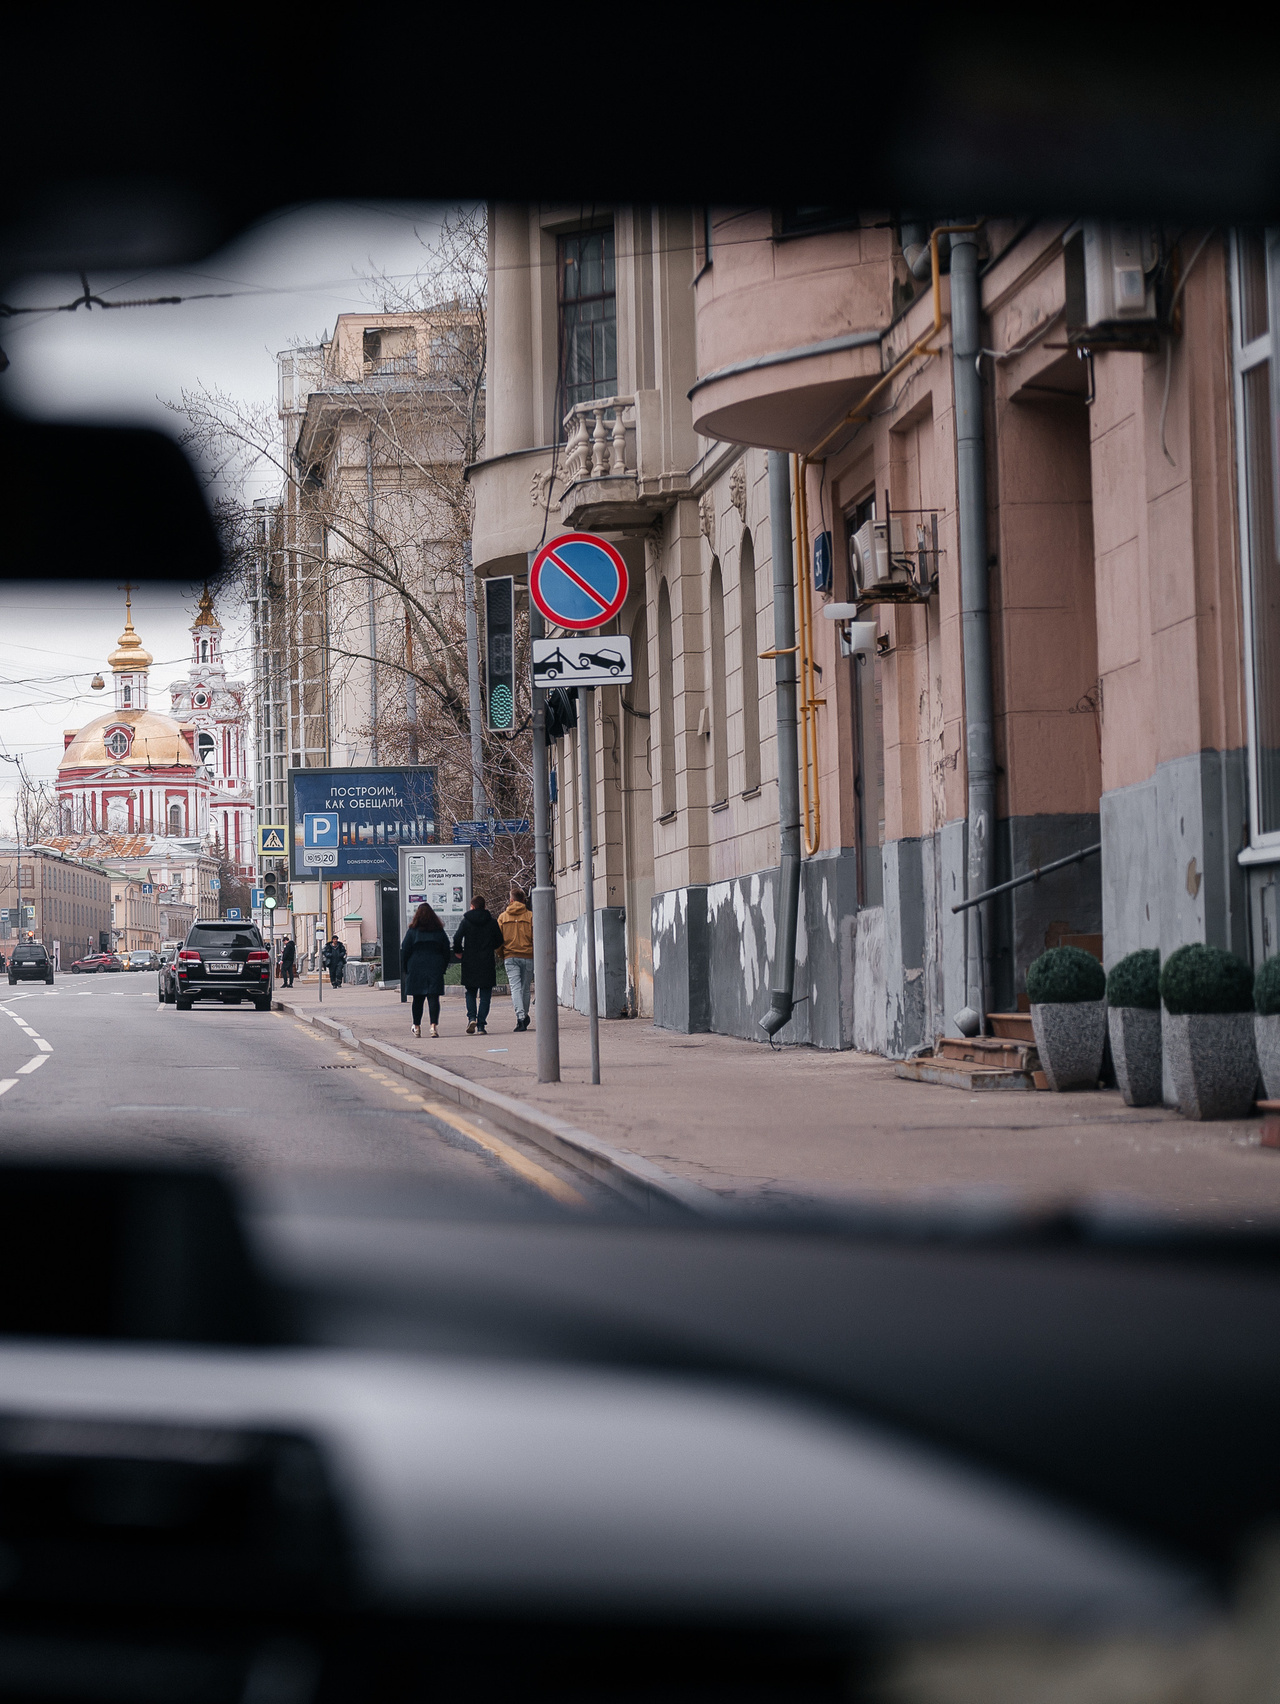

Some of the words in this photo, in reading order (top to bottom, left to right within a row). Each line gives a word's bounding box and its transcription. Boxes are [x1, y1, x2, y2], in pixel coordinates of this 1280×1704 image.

[330, 786, 397, 797] ПОСТРОИМ,
[325, 799, 345, 809] КАК
[349, 798, 403, 809] ОБЕЩАЛИ
[313, 817, 331, 844] P
[324, 854, 334, 862] 20
